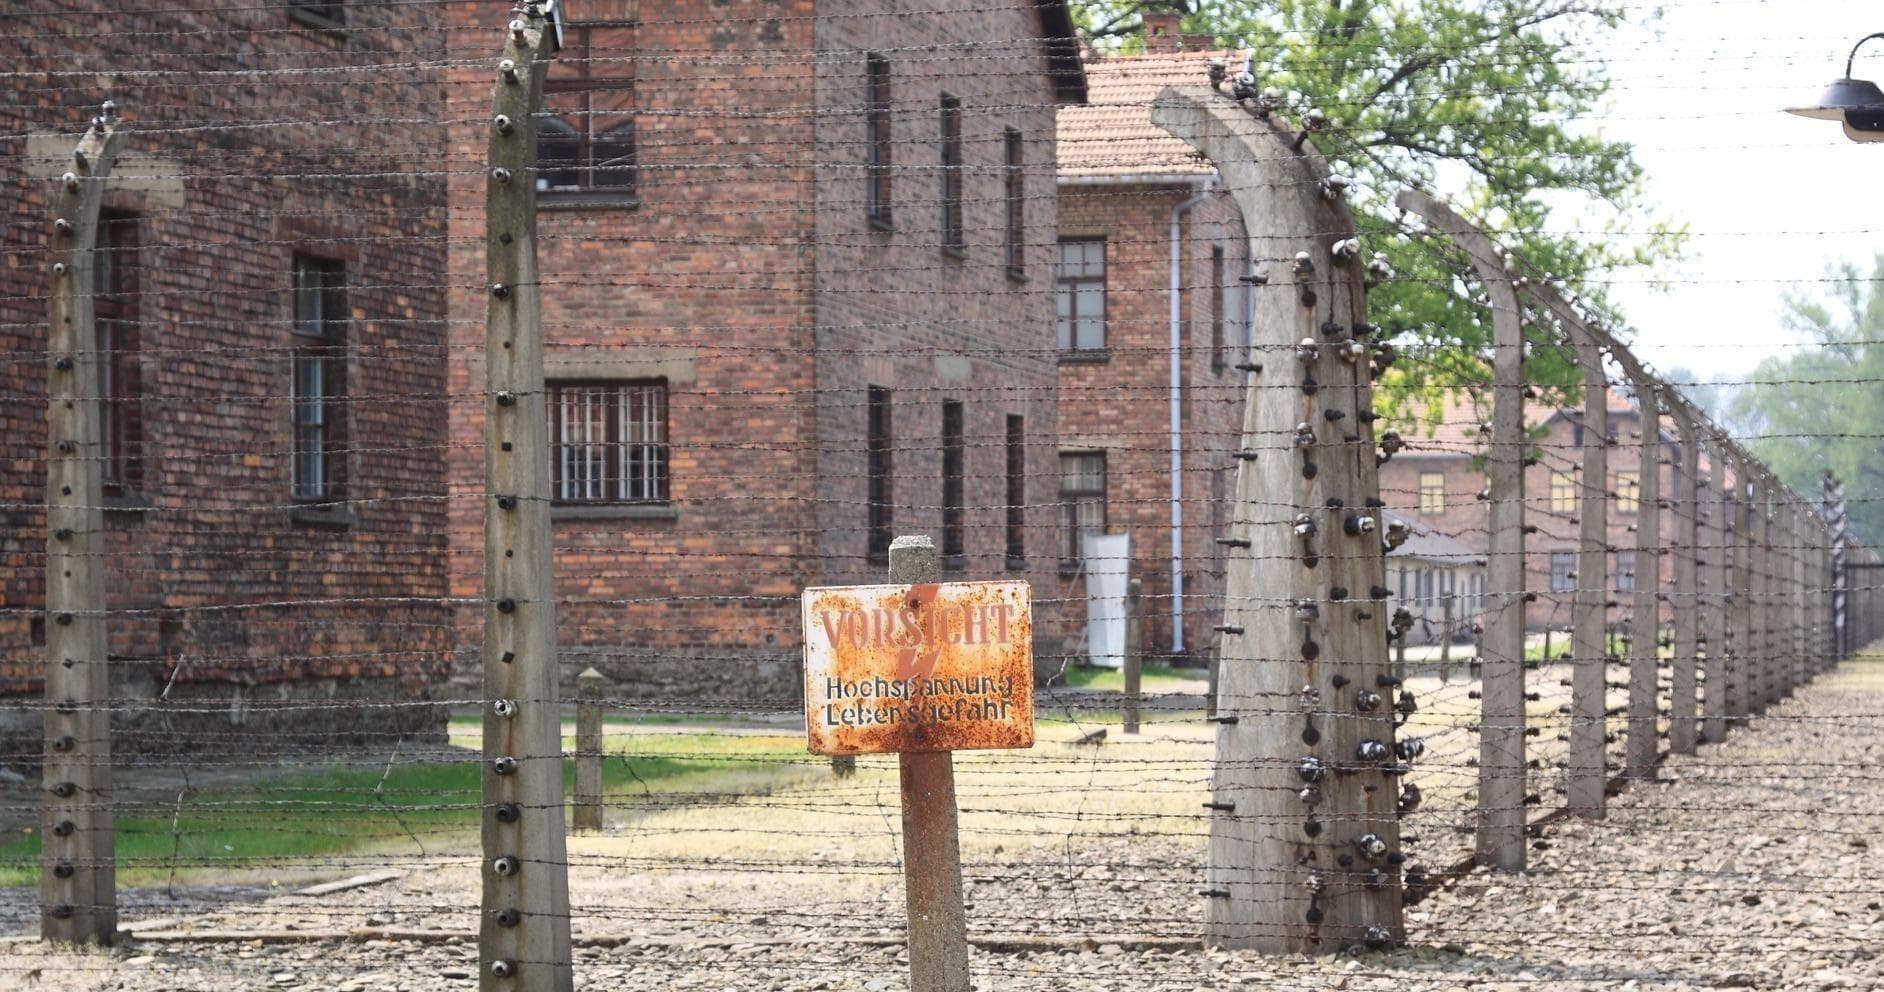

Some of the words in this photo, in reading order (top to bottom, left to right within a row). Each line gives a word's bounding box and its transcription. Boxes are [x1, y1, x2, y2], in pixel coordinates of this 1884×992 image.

[820, 603, 1015, 649] VORSICHT
[827, 675, 1013, 700] Hochspannung
[827, 699, 1013, 726] Lebensgefahr
